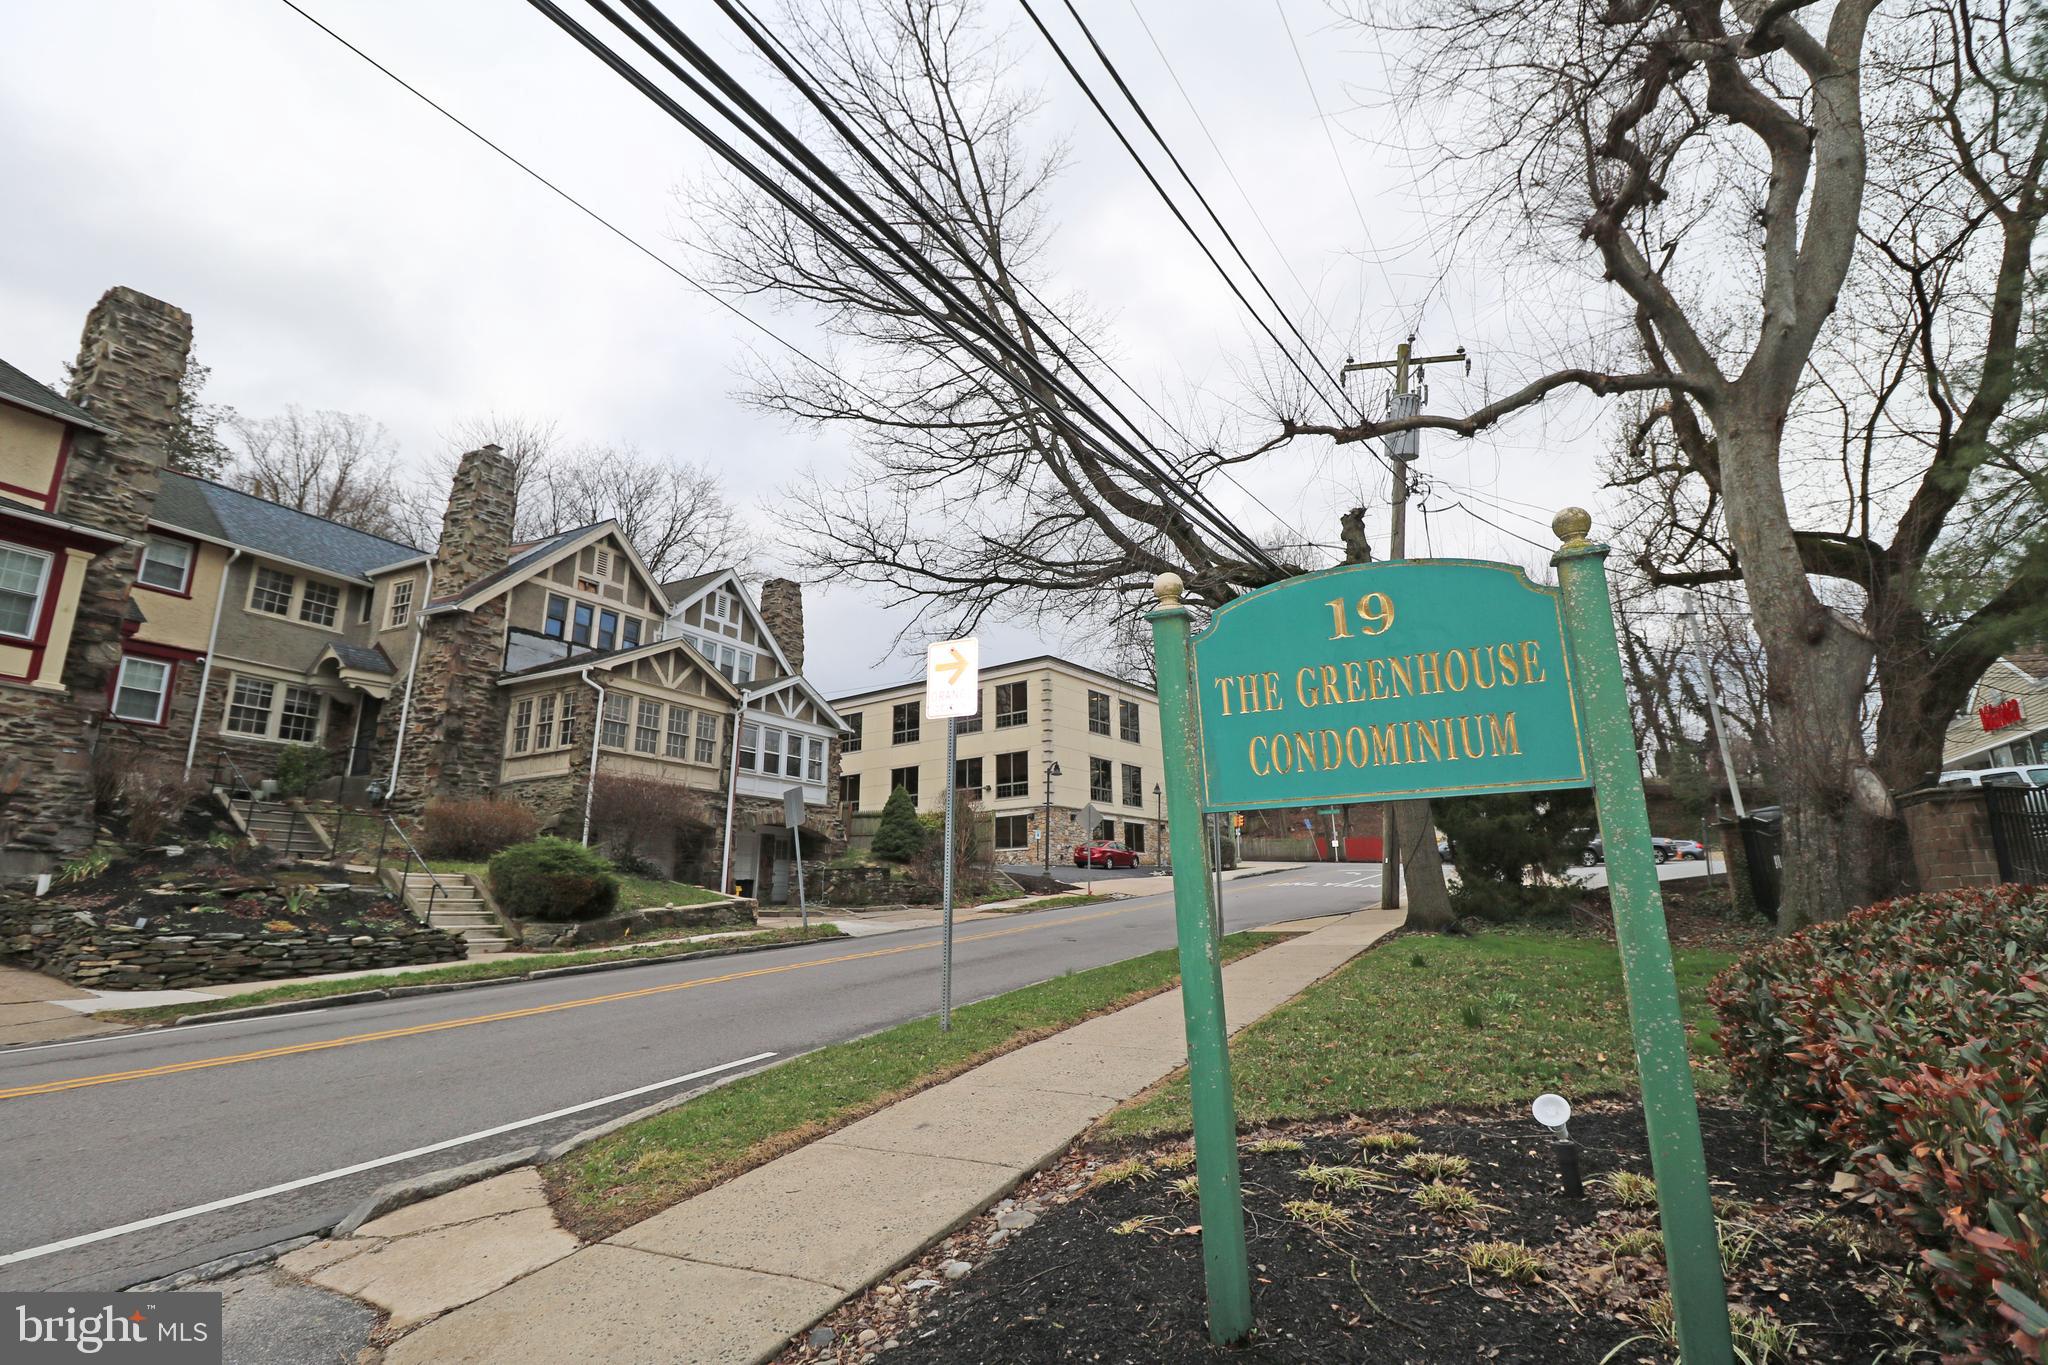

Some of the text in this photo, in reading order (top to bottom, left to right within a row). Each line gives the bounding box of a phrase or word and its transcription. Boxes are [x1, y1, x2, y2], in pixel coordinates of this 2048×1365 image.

[1324, 591, 1395, 640] 19
[1214, 639, 1546, 716] THE GREENHOUSE
[1249, 711, 1523, 777] CONDOMINIUM
